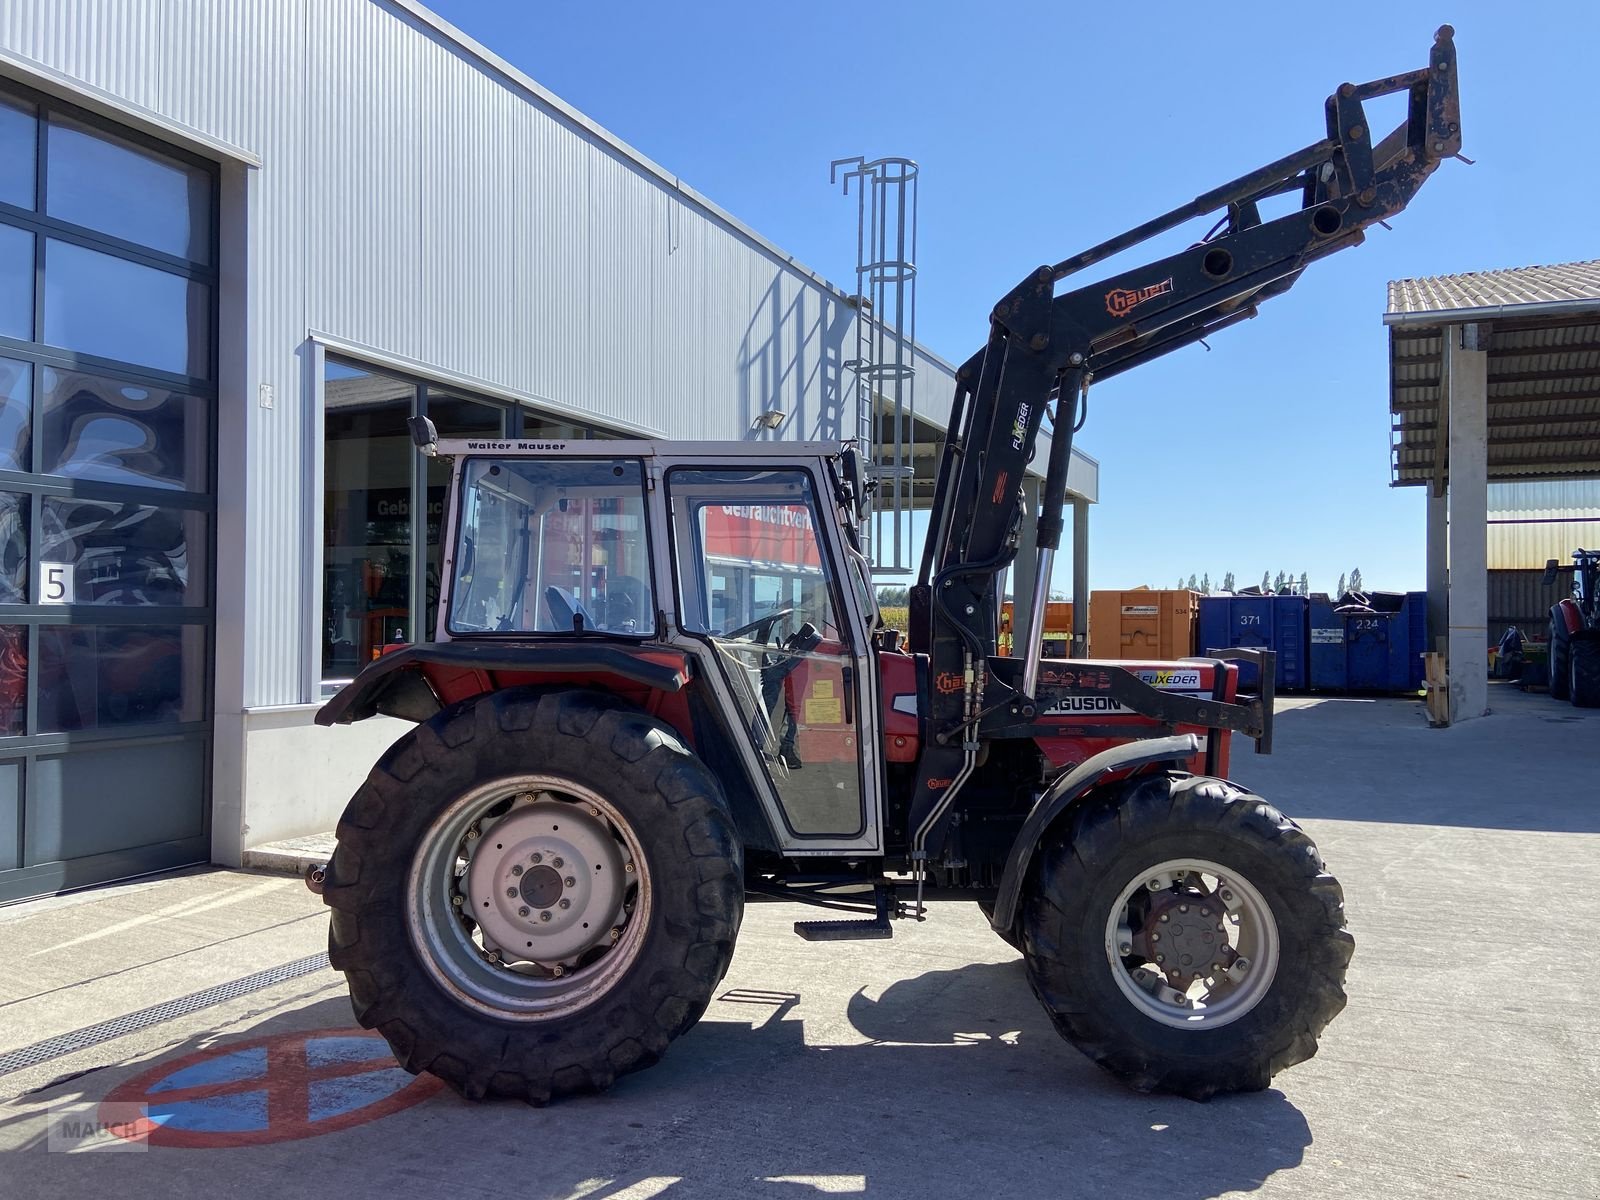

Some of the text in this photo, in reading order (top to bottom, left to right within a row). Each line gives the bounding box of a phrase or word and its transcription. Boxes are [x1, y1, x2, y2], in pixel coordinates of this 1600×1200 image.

[1110, 279, 1170, 312] hauer
[467, 442, 566, 451] Walter Mauser
[47, 568, 65, 600] 5
[1240, 615, 1261, 625] 371
[1356, 619, 1379, 630] 224
[1142, 674, 1198, 685] FLIXEDER
